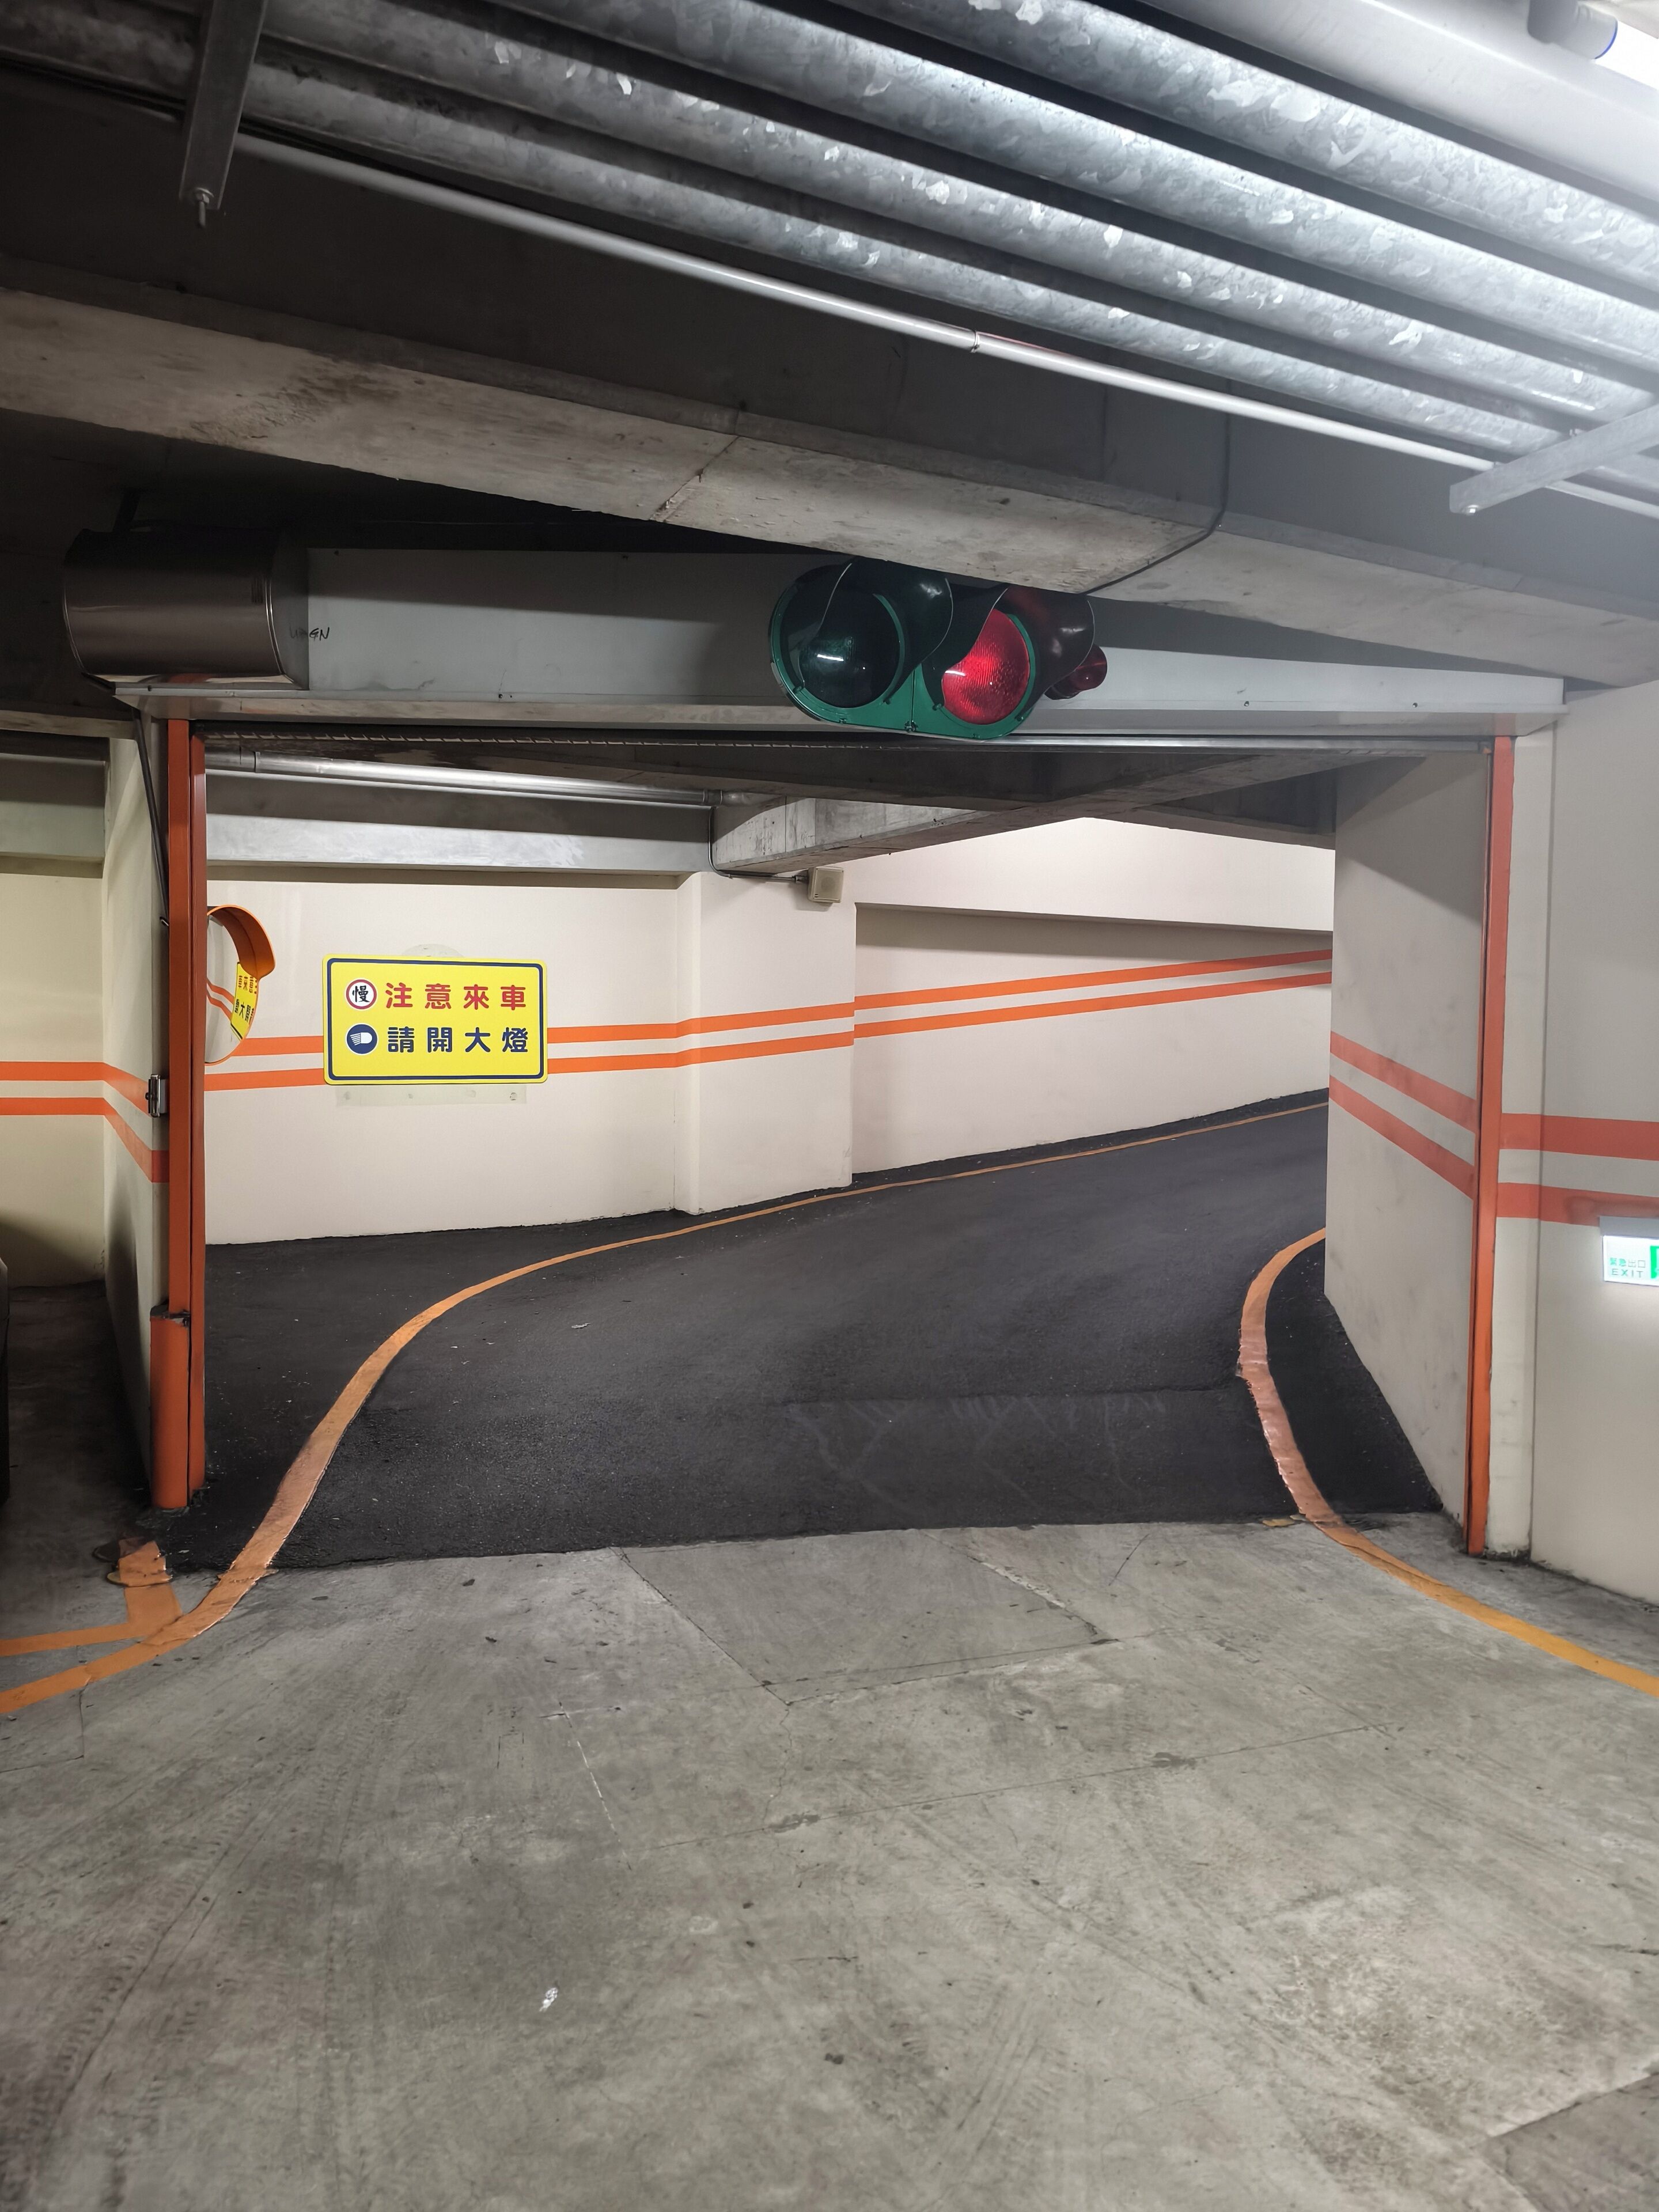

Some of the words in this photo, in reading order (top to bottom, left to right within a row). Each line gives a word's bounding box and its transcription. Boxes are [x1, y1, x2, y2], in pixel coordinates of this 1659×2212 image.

[352, 985, 370, 1003] 慢
[385, 982, 527, 1011] 注意來車
[387, 1026, 528, 1053] 請開大燈
[1611, 1268, 1644, 1278] EXIT
